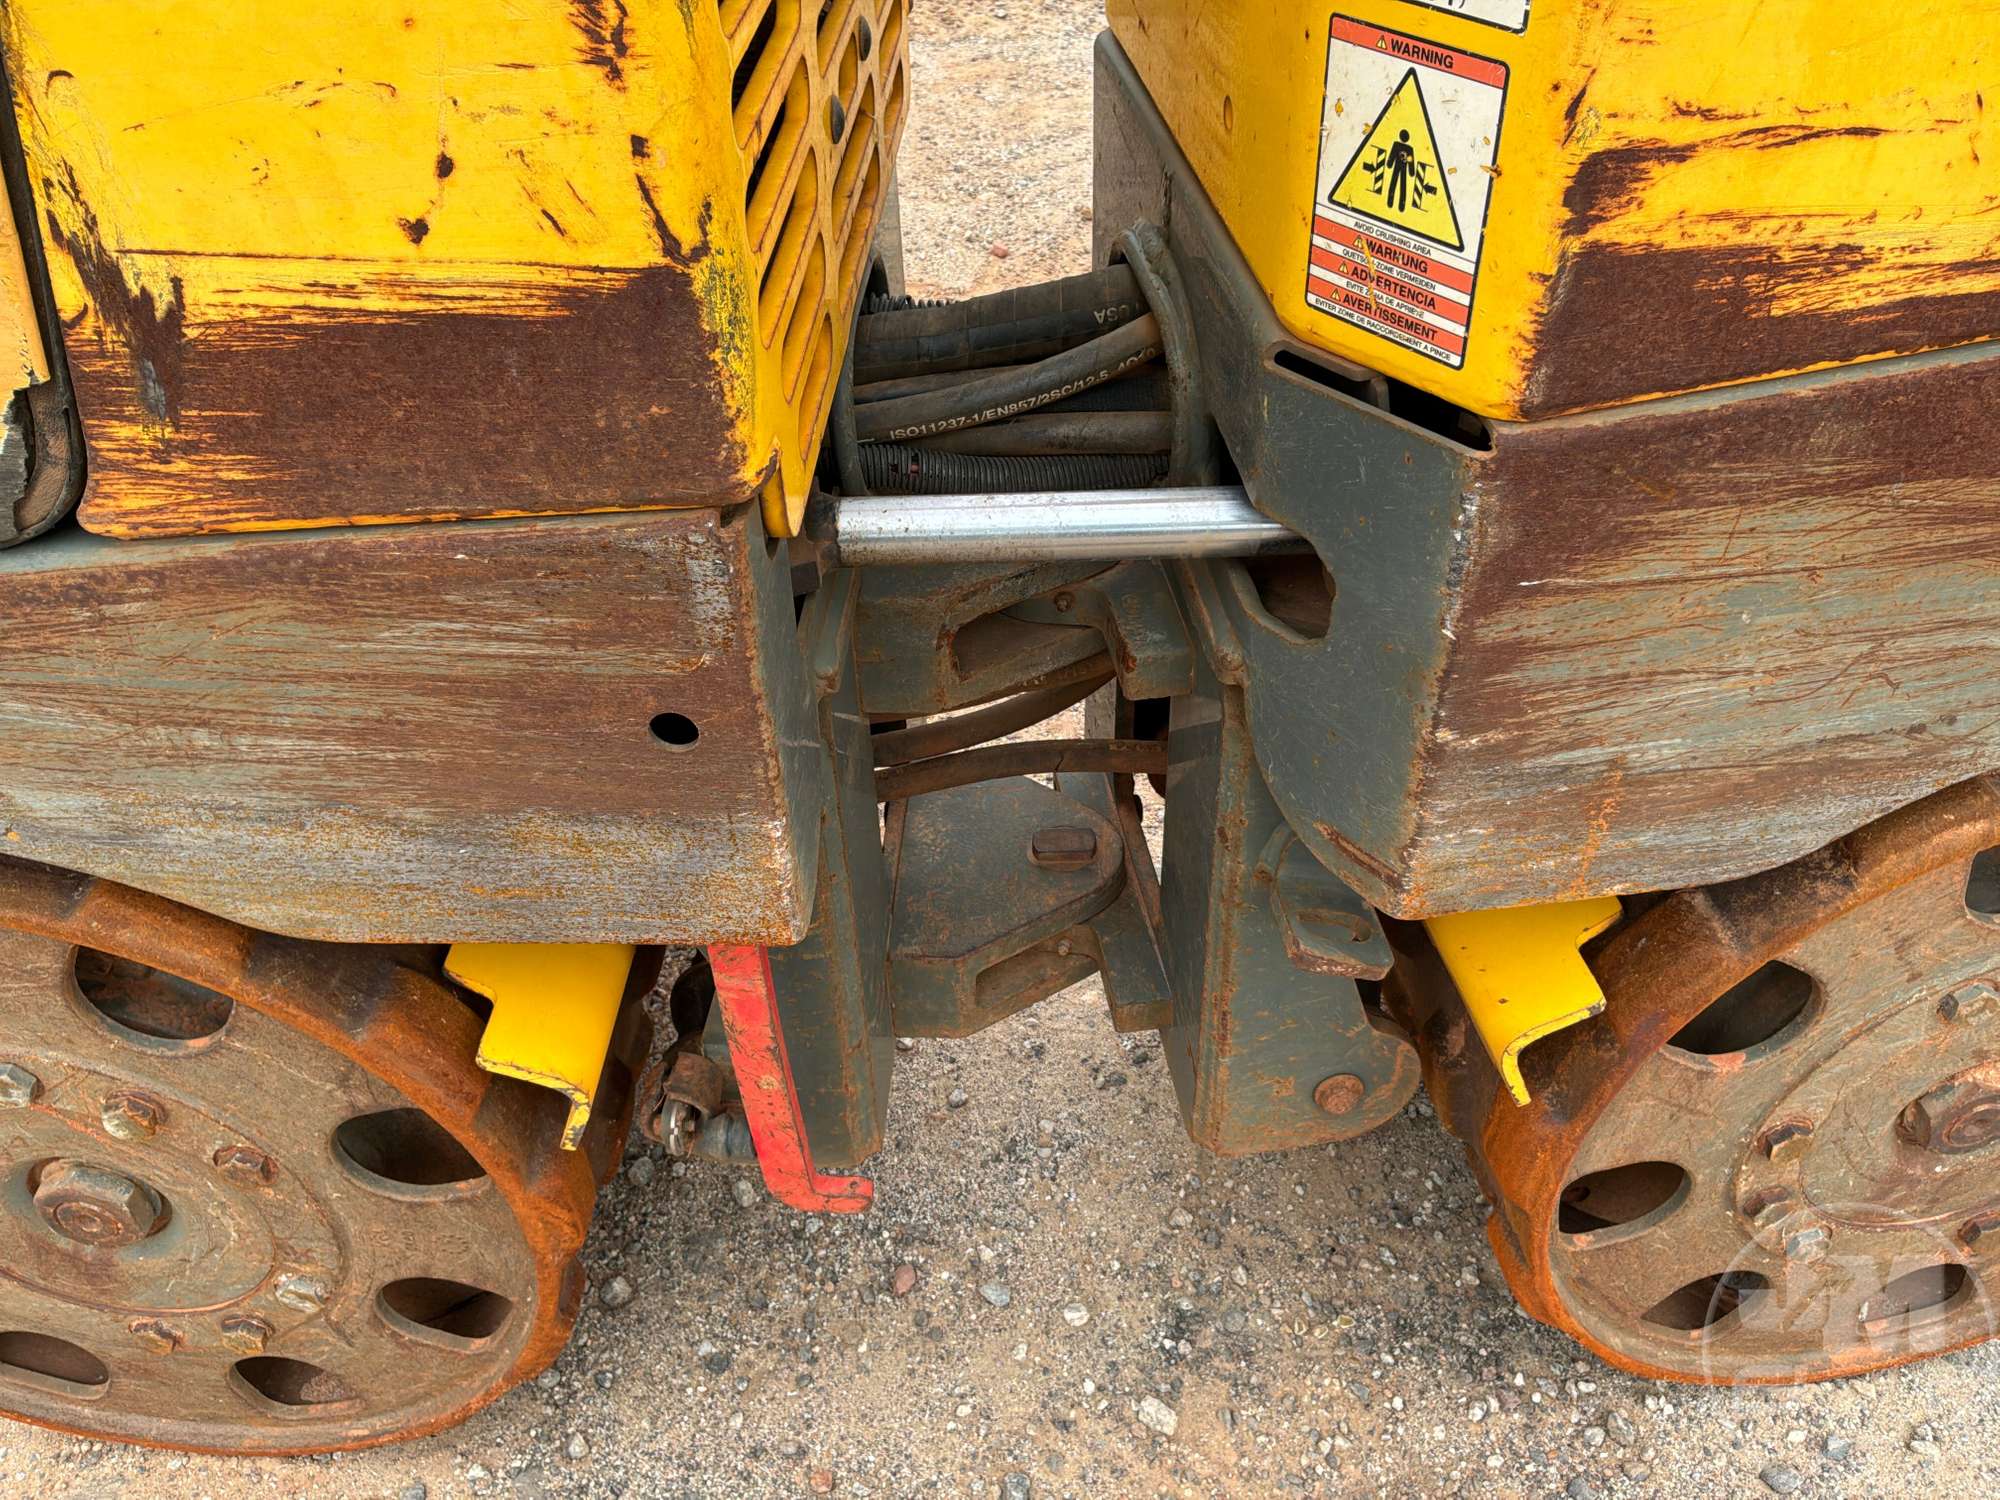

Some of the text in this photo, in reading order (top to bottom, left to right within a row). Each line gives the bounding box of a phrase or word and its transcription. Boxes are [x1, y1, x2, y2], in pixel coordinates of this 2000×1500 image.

[1391, 38, 1454, 69] WARNING
[1354, 221, 1432, 256] AVOID CRUSHING AREA
[1346, 281, 1365, 295] EVITE
[1365, 286, 1385, 302] ZNA
[1385, 294, 1396, 306] DE
[1351, 266, 1437, 310] ADVERTENCIA
[1396, 267, 1436, 291] VERMEIDEN
[1315, 297, 1337, 312] EVITER
[1337, 307, 1355, 320] ZONE
[1355, 313, 1366, 325] DE
[1430, 346, 1451, 361] PINCE
[1342, 293, 1438, 341] AVERTISSEMENT
